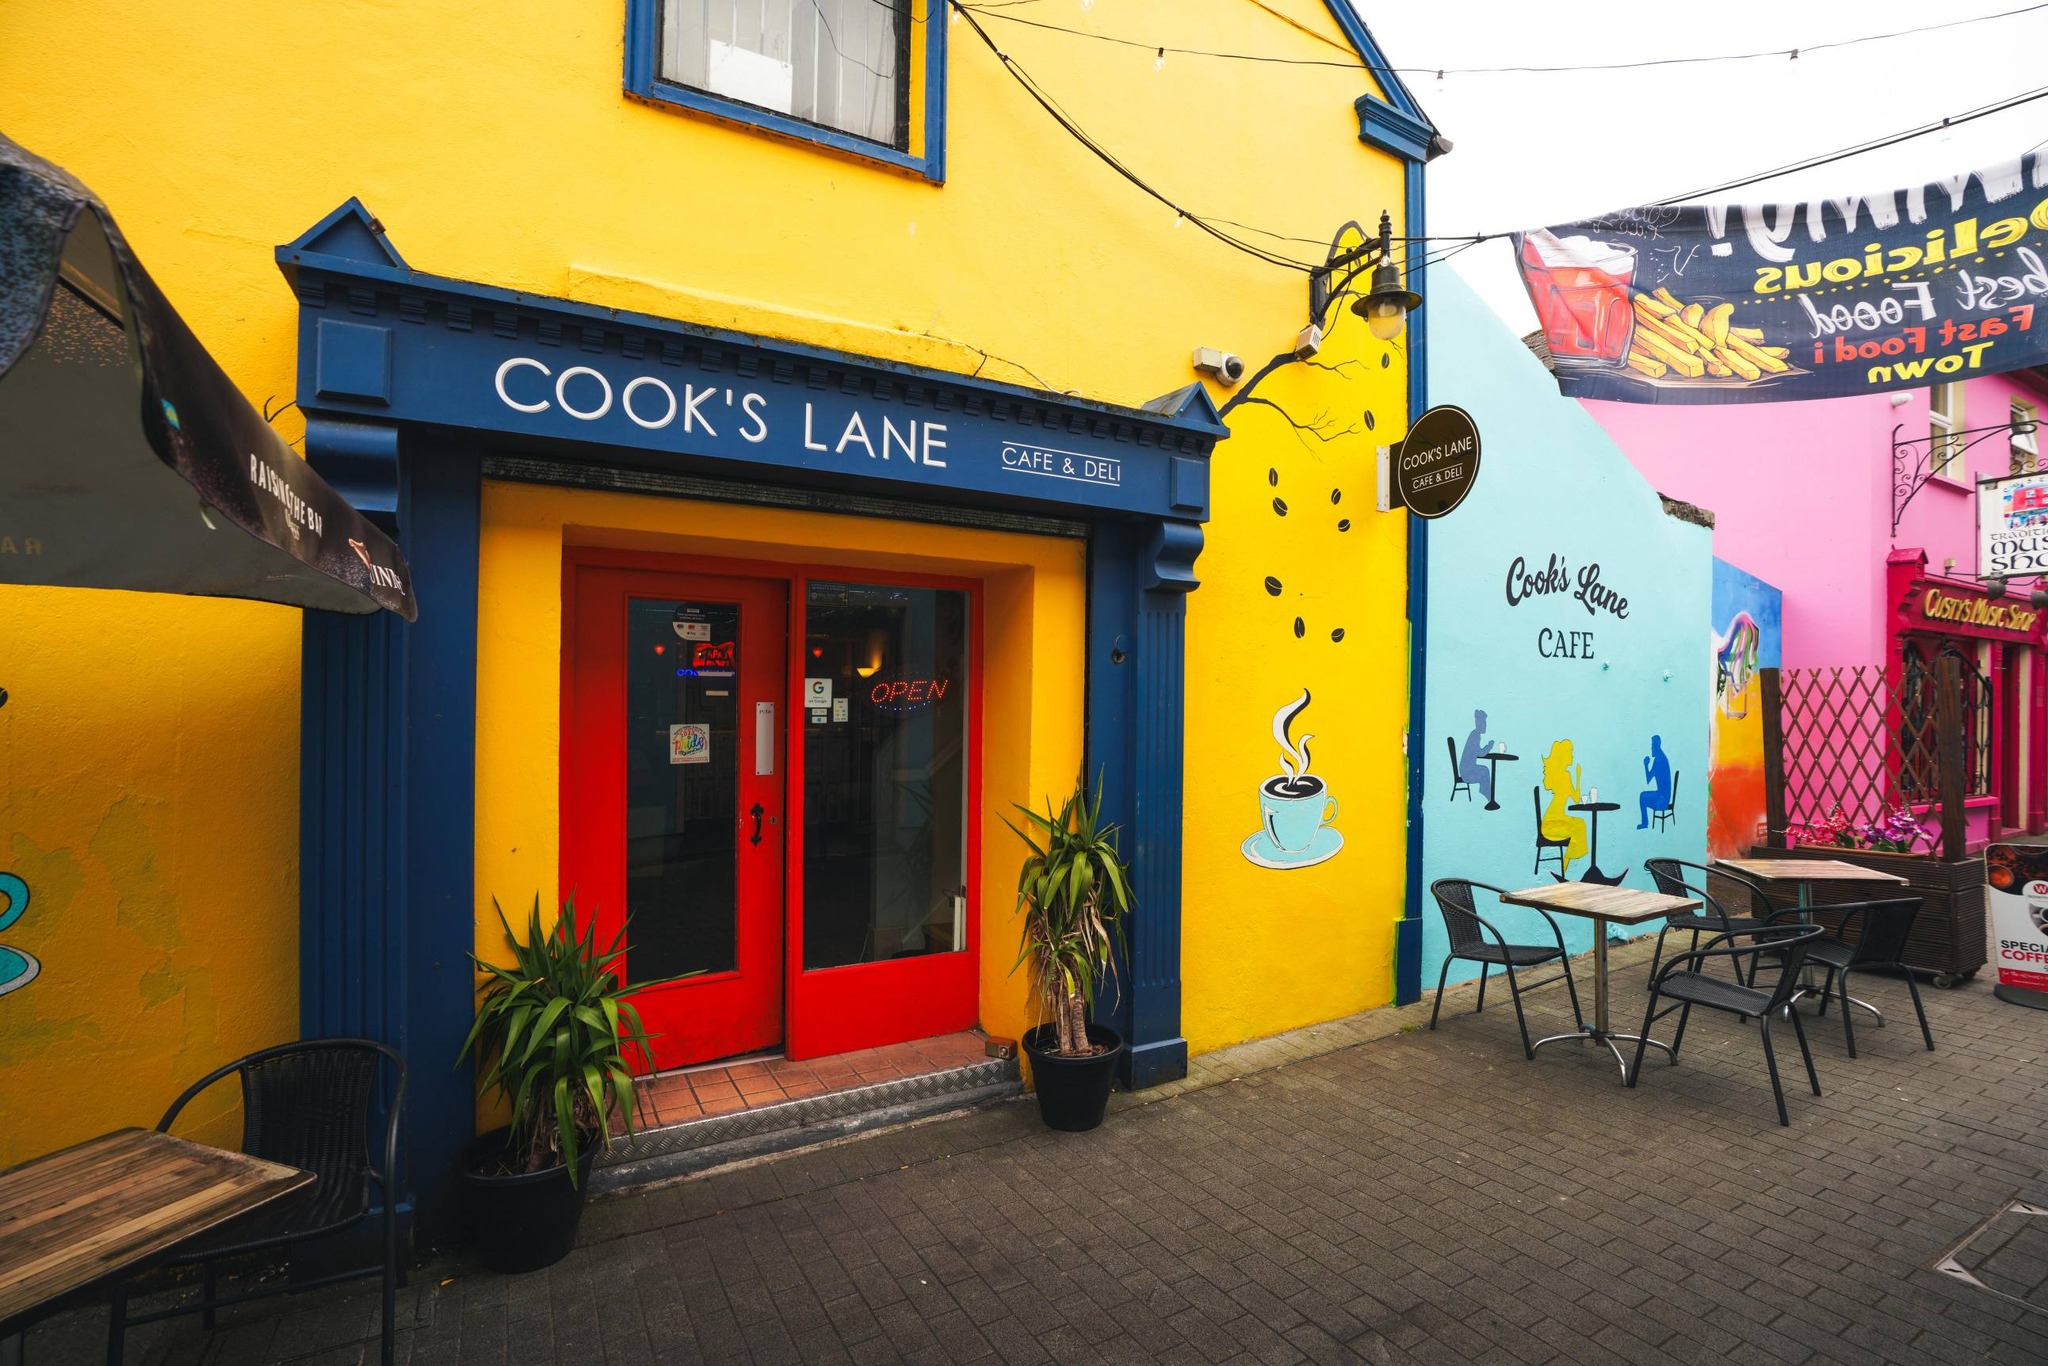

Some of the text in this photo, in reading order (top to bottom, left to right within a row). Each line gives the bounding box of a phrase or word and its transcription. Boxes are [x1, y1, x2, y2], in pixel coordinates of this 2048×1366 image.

[494, 356, 948, 468] COOK'S LANE
[1001, 447, 1121, 482] CAFE & DELI
[1403, 436, 1472, 471] COOK'S LANE
[1412, 466, 1463, 490] CAFE & DELI
[1506, 553, 1630, 620] Cook's Lane
[1538, 627, 1595, 660] CAFE
[871, 679, 949, 704] OPEN
[2001, 940, 2048, 953] SPECI
